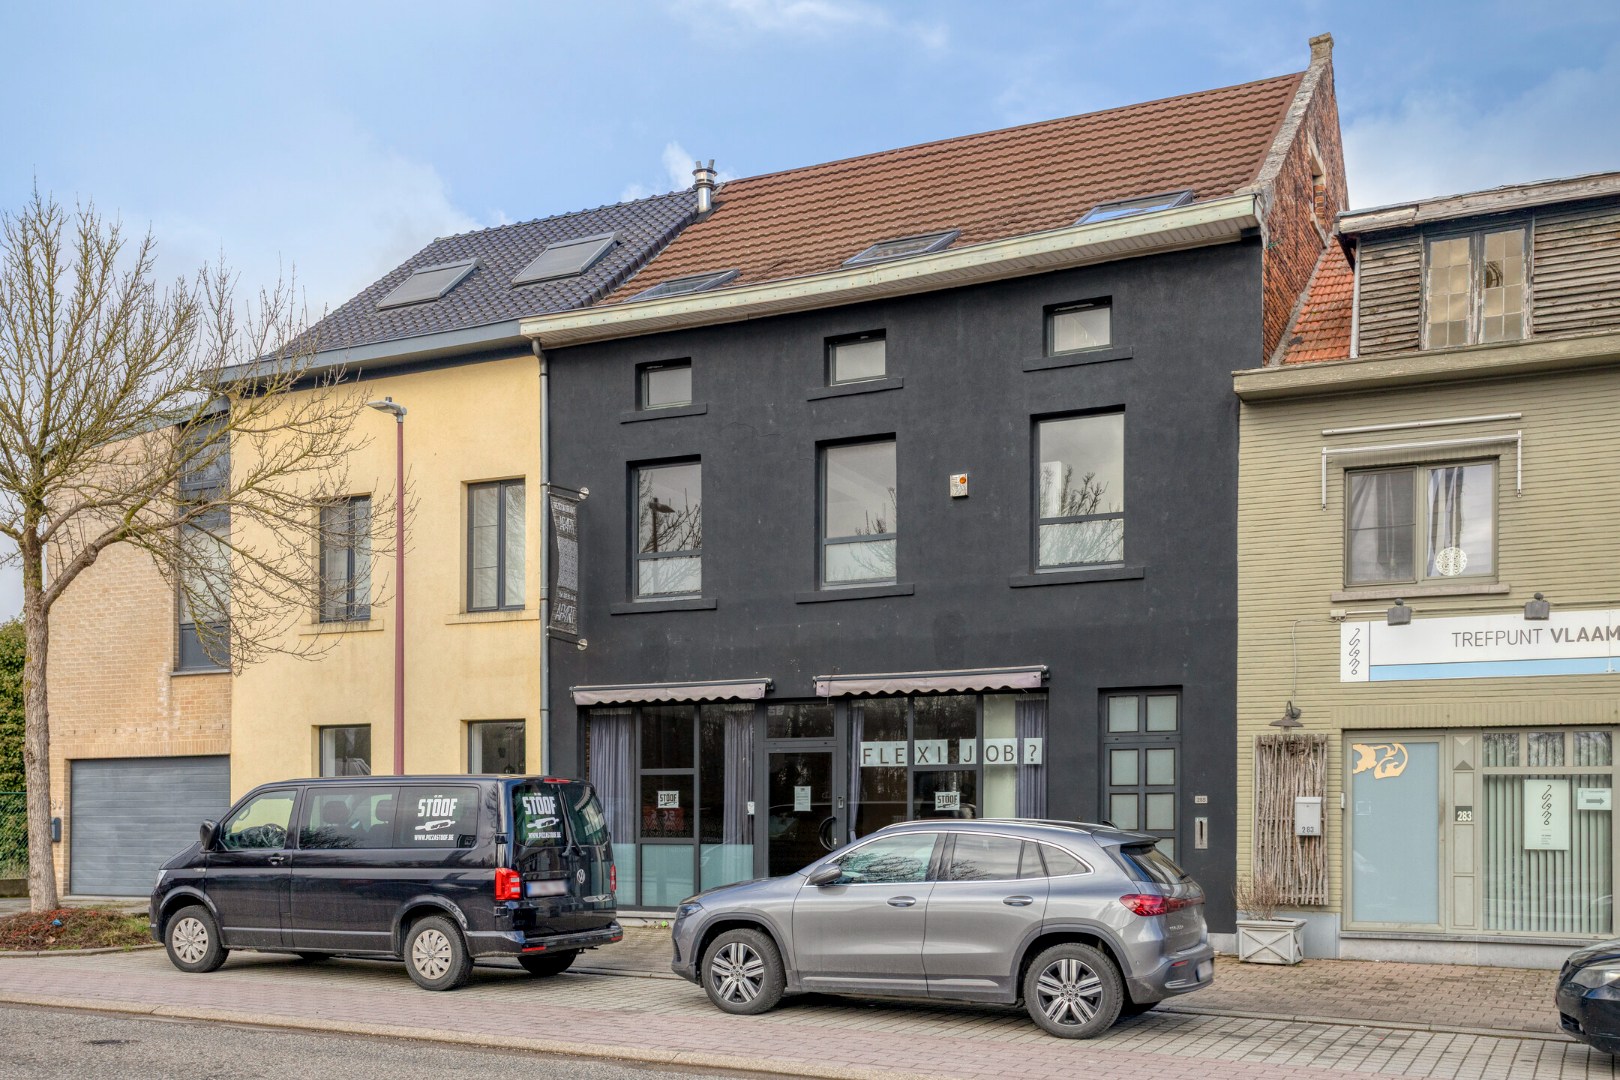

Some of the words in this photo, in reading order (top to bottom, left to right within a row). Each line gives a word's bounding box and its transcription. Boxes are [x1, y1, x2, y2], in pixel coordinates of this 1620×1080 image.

[1451, 628, 1543, 648] TREFPUNT
[1550, 625, 1620, 643] VLAAM
[862, 746, 941, 765] FLEXI
[963, 744, 1015, 763] JOB
[1457, 810, 1472, 821] 283
